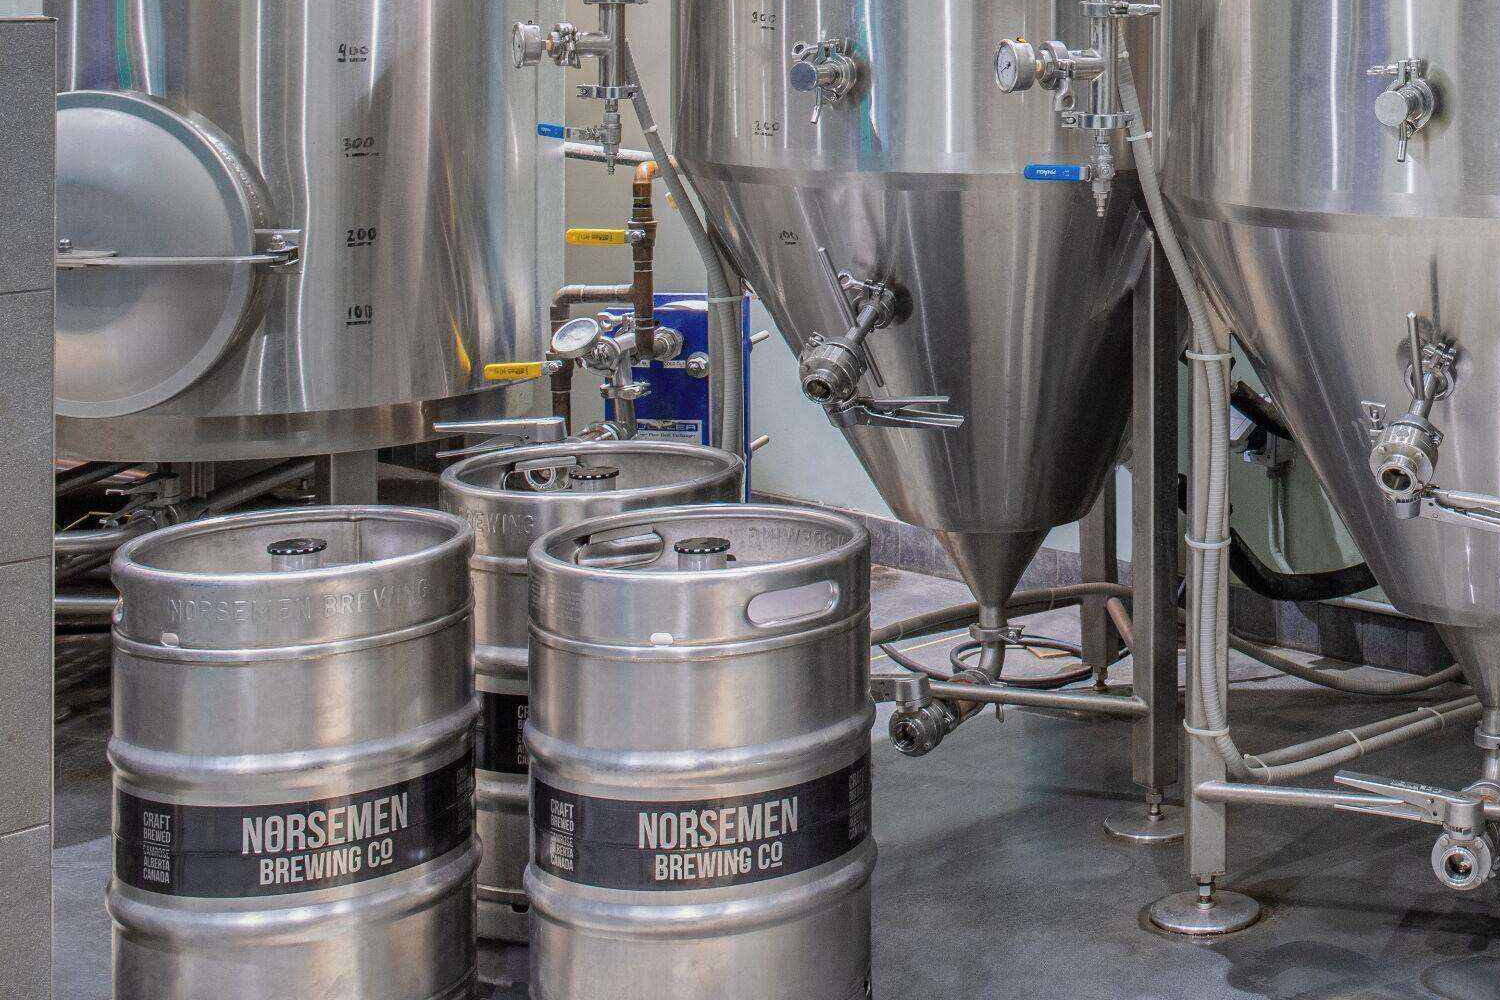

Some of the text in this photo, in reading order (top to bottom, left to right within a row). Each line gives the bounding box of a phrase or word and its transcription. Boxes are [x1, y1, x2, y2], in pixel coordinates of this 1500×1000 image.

[343, 137, 375, 151] 300
[347, 227, 377, 242] 200
[348, 305, 373, 321] 100
[457, 505, 534, 535] REWING
[170, 574, 430, 624] NORSEMEN BREWING
[550, 799, 574, 819] CRAFT
[143, 811, 171, 830] CRAFT
[550, 815, 574, 832] BREWED
[638, 796, 798, 850] NORSEMEN
[143, 827, 171, 843] BREWED
[550, 831, 574, 848] ROSE
[143, 856, 170, 871] ALBERTA
[260, 846, 362, 886] BREWING
[550, 853, 574, 872] CANADA
[655, 847, 752, 881] BREWING
[143, 867, 170, 884] CANADA
